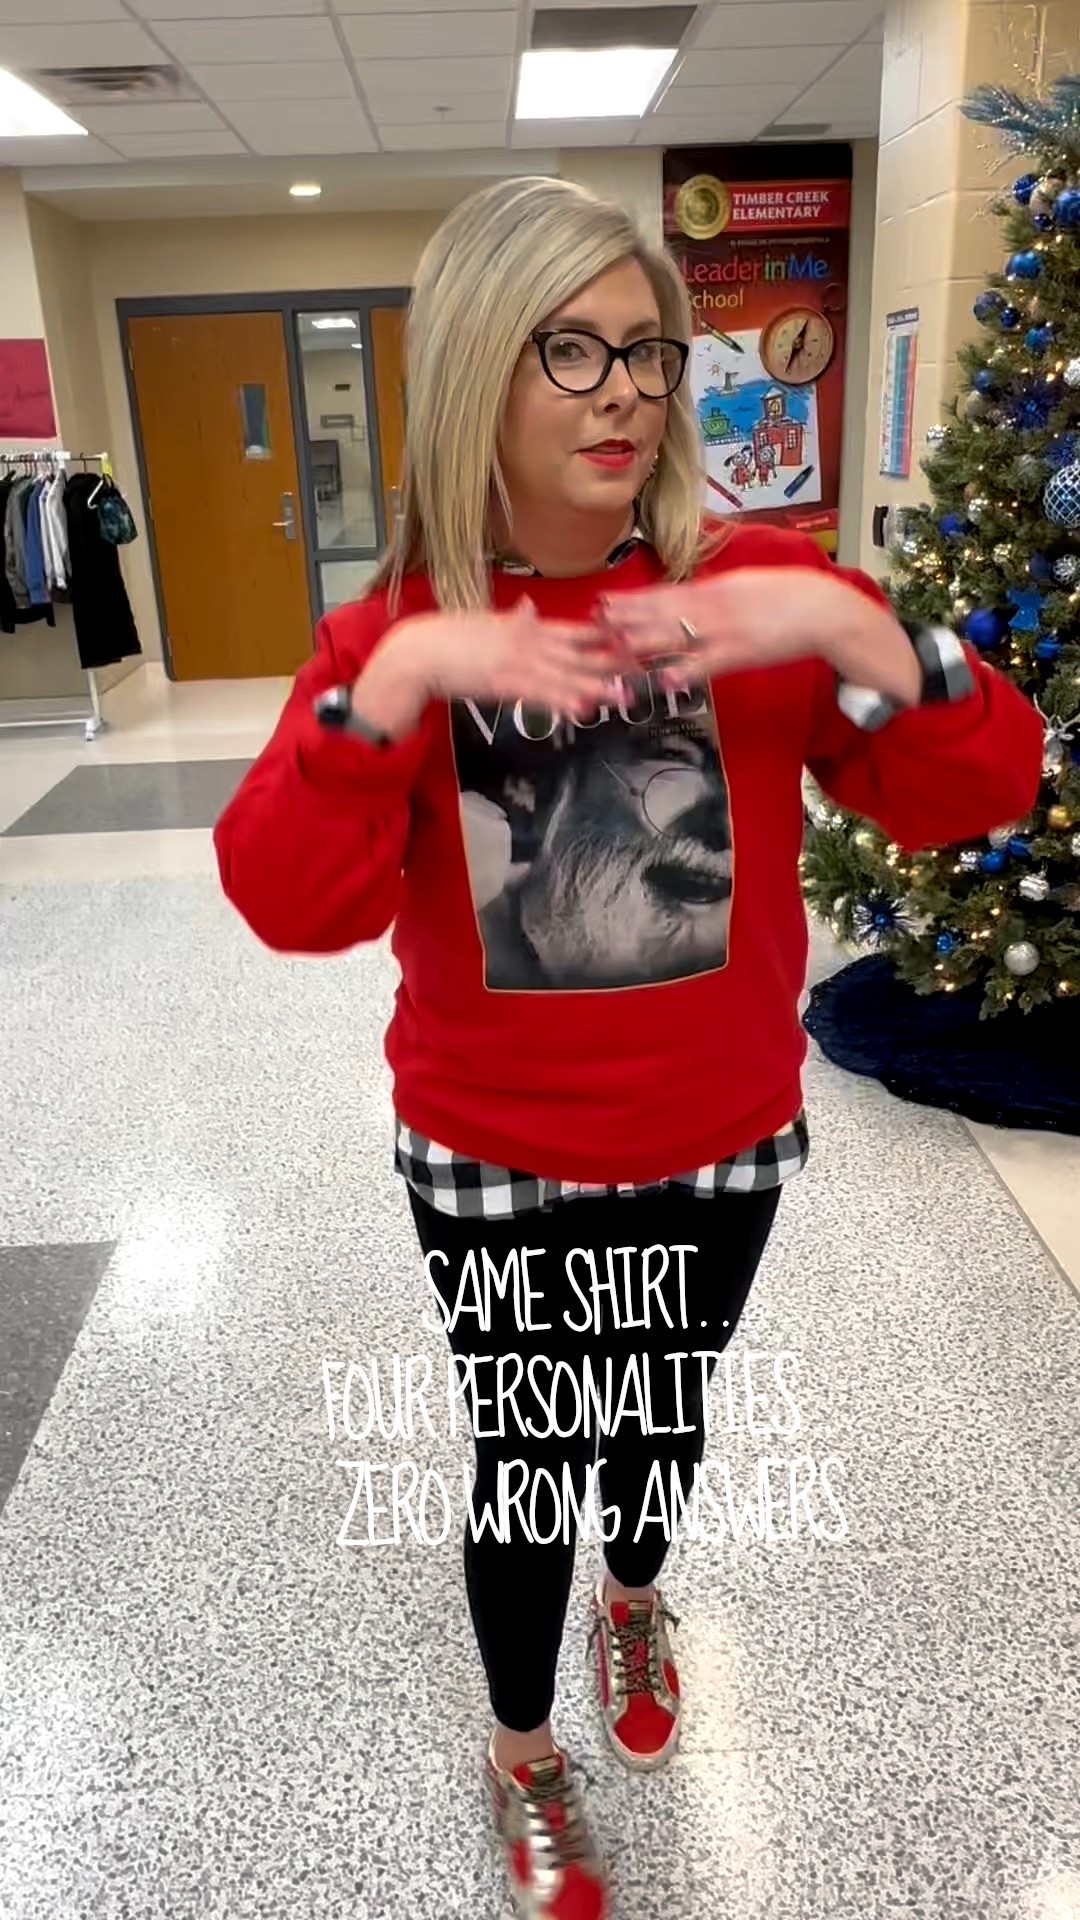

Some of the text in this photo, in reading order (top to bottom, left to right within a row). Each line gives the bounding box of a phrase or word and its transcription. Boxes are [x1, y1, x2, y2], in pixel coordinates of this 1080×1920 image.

[733, 191, 829, 205] TIMBER CREEK
[732, 206, 821, 220] ELEMENTARY
[692, 288, 744, 308] chool
